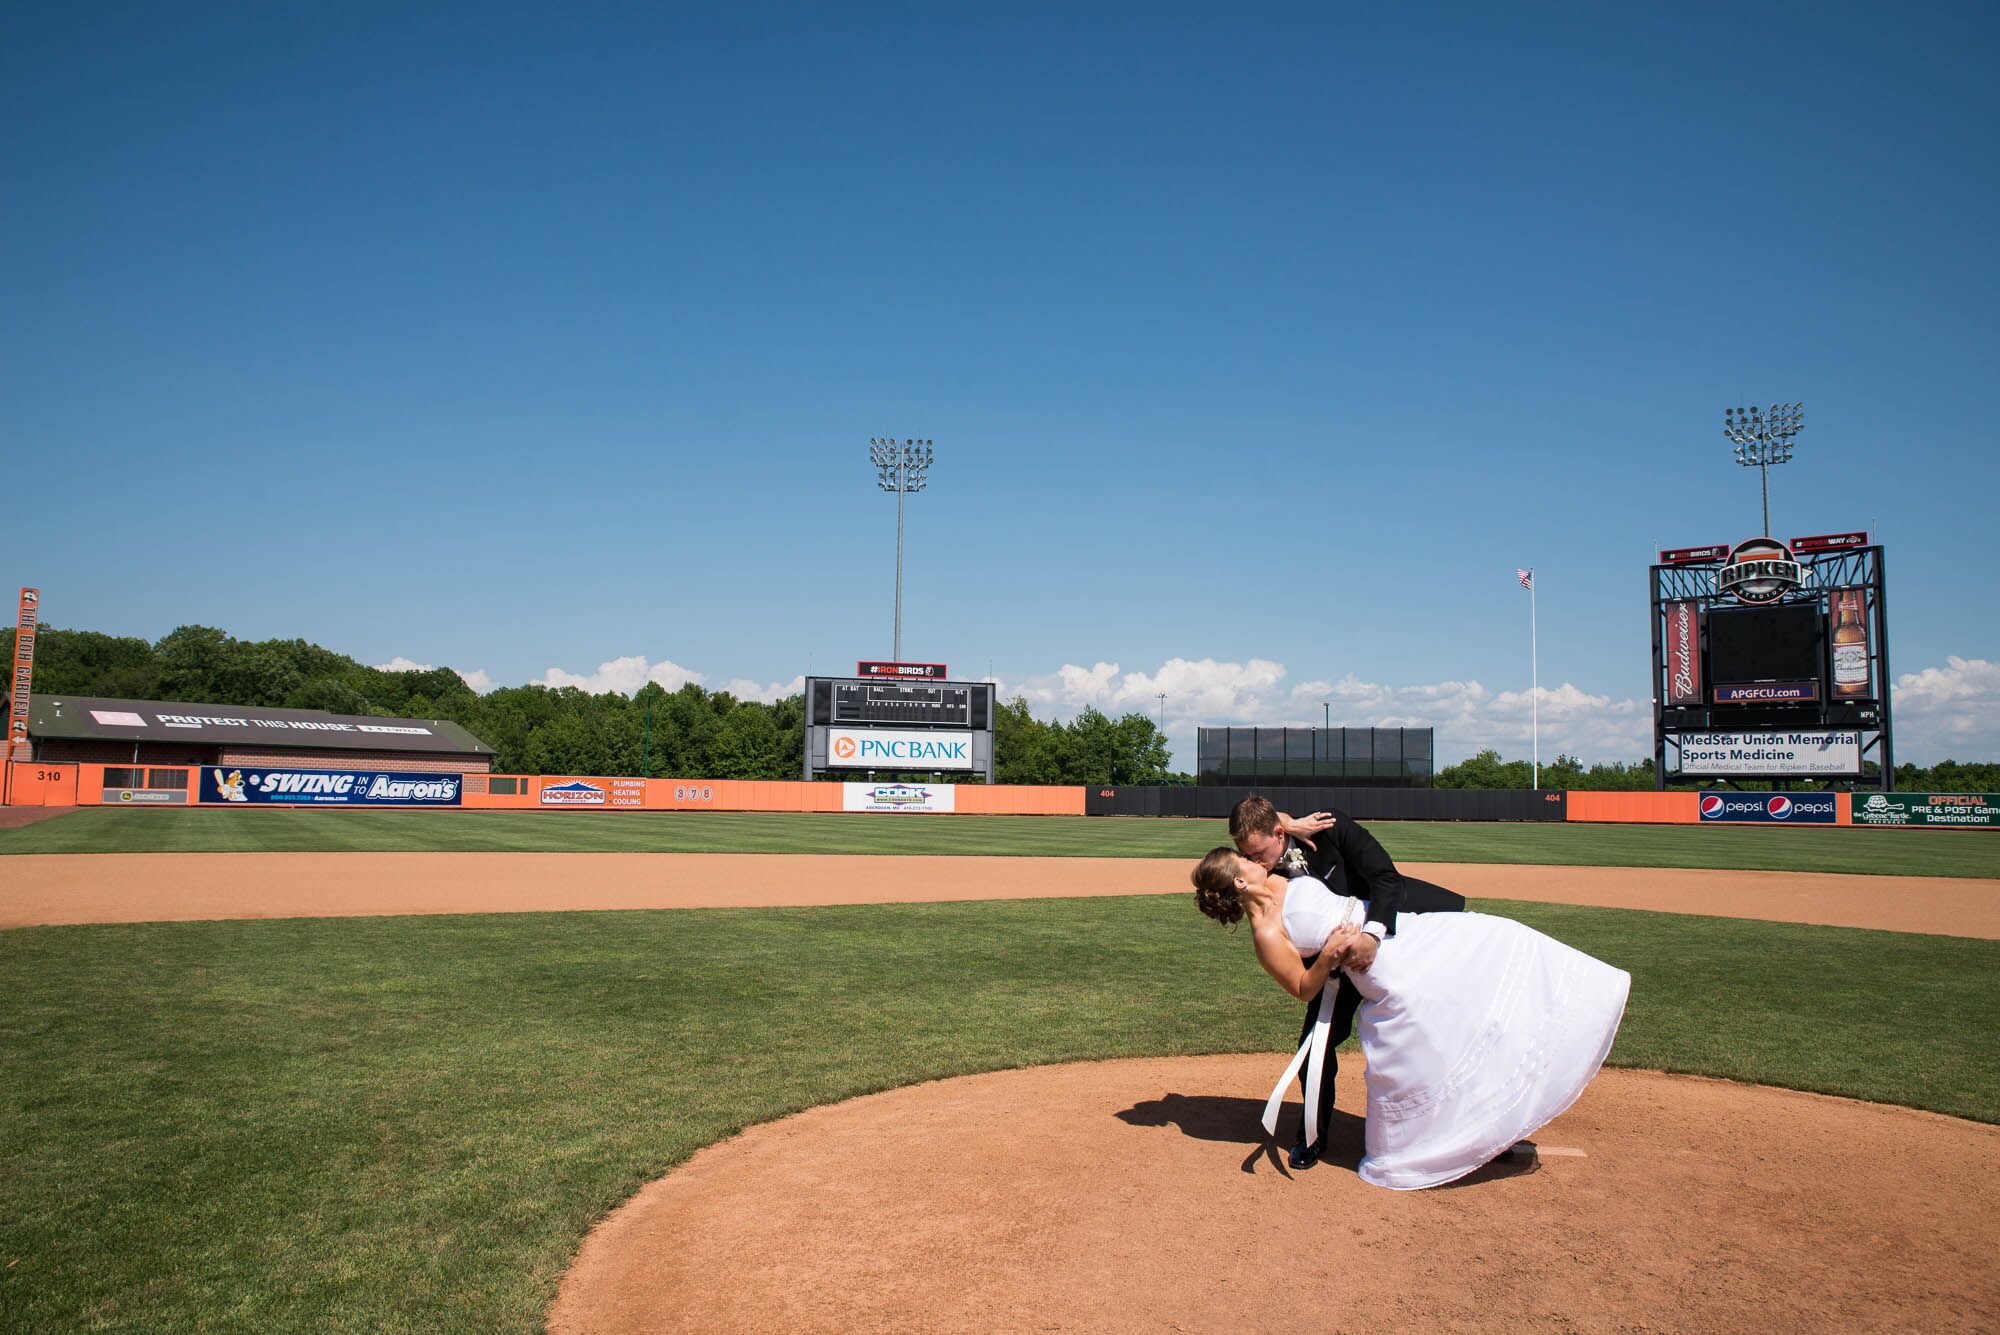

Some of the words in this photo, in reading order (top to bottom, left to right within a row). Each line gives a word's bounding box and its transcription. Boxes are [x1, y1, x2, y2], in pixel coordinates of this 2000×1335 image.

[1721, 560, 1800, 583] RIPKEN
[21, 607, 36, 631] THE
[18, 634, 33, 662] BOH
[1675, 601, 1692, 699] Budweiser
[870, 665, 924, 675] #IRONBIRDS
[14, 665, 31, 717] GARDEN
[1730, 688, 1800, 699] APGFCU.com
[156, 714, 248, 727] PROTECT
[250, 719, 289, 728] THIS
[1682, 733, 1739, 746] MedStar
[1743, 733, 1784, 745] Union
[1788, 733, 1858, 745] Memorial
[1682, 749, 1726, 762] Sports
[1730, 749, 1795, 760] Medicine
[1711, 763, 1742, 771] Medical
[1744, 763, 1765, 771] Team
[1766, 763, 1777, 771] for
[1779, 763, 1808, 772] Ripken
[1809, 763, 1846, 771] Baseball
[38, 771, 60, 781] 310
[357, 776, 369, 785] IN
[259, 773, 354, 793] SWING
[366, 774, 457, 800] Aaron's
[613, 780, 646, 788] PLUMBING
[354, 785, 367, 794] TO
[613, 789, 641, 797] HEATING
[1100, 790, 1115, 798] 404
[543, 791, 604, 800] HORIZON
[1545, 794, 1560, 802] 404
[1928, 795, 1987, 806] OFFICIAL
[1726, 801, 1763, 813] pepsi
[1794, 802, 1834, 814] pepsi
[1912, 806, 1932, 814] PRE
[1935, 806, 1943, 814] &
[1945, 806, 1972, 814] POST
[1927, 814, 1990, 823] Destination!
